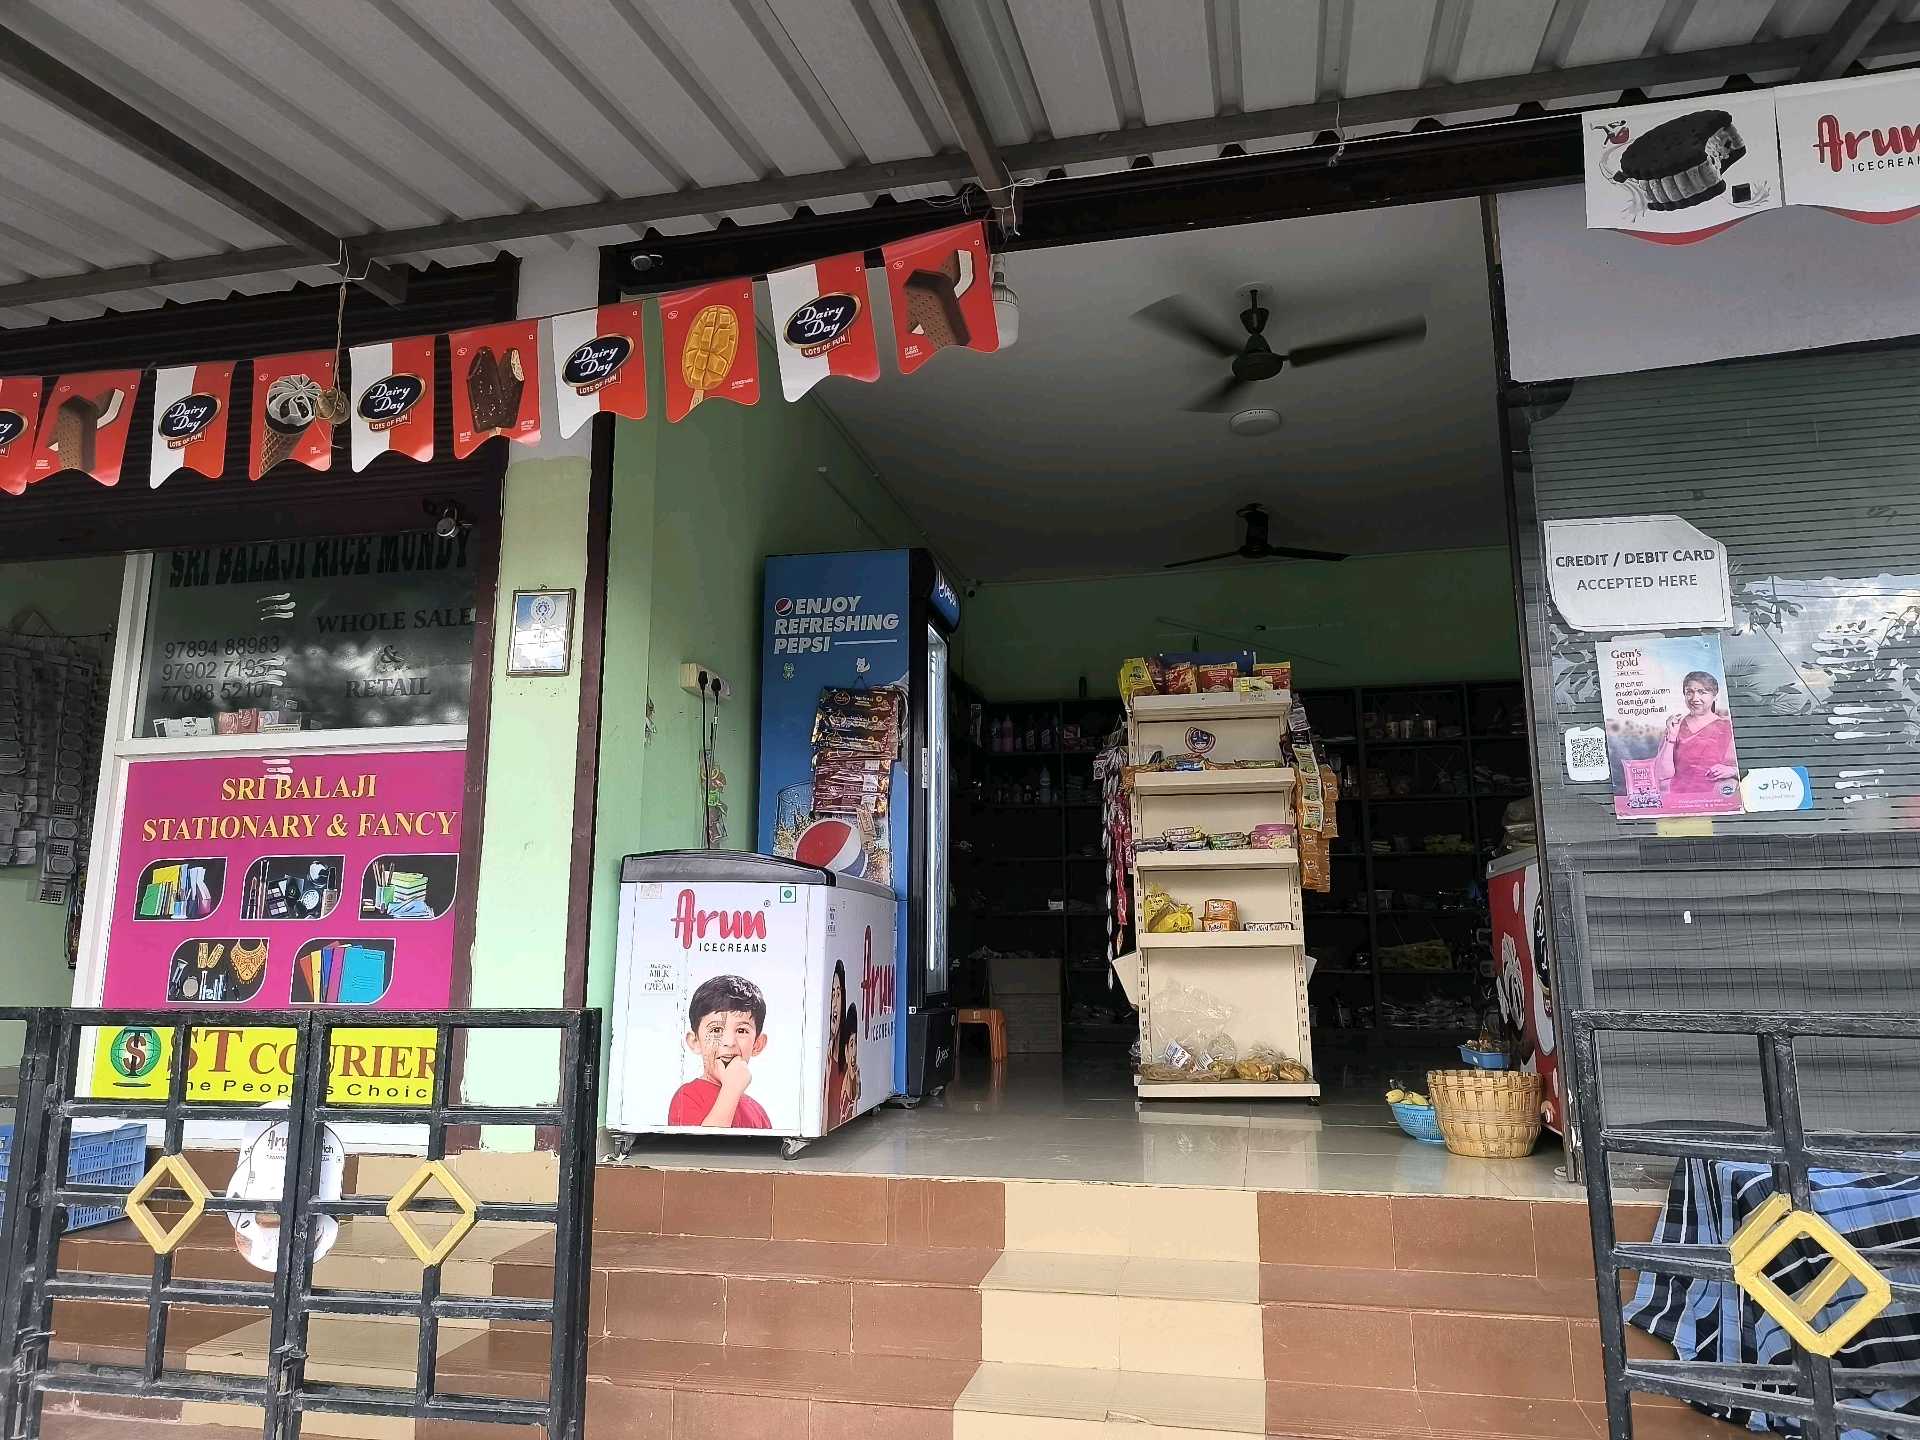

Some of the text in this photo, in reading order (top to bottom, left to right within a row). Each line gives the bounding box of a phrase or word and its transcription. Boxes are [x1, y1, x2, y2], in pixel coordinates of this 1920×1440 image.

[797, 305, 845, 326] Dairy
[805, 320, 840, 338] Day
[804, 334, 846, 356] LOTS OF FUN
[574, 346, 619, 364] Dairy
[580, 359, 613, 376] Day
[369, 383, 411, 399] Dairy
[579, 375, 617, 395] LOTS OF FUN
[170, 402, 207, 418] Dairy
[374, 396, 405, 414] Day
[172, 415, 202, 432] Day
[371, 413, 408, 430] LOTS OF FUN
[169, 433, 202, 448] LOTS OF FUN
[169, 548, 210, 588] SRI
[216, 542, 305, 585] BALAJI
[1555, 548, 1715, 568] CREDIT / DEBIT CARD
[1577, 574, 1698, 591] ACCEPTED HERE
[795, 595, 862, 615] ENJOY
[317, 607, 473, 634] WHOLE SALE
[774, 613, 900, 635] REFRESHING
[164, 635, 280, 660] 97894 88983
[379, 644, 405, 664] &
[774, 636, 831, 655] PEPSI
[1610, 648, 1642, 660] Gem's
[162, 661, 217, 682] 97902
[1616, 658, 1639, 670] gold
[345, 677, 432, 698] RETAIL
[221, 774, 377, 801] SRI BALAJI
[1771, 779, 1793, 792] Pay
[142, 811, 458, 842] STATIONARY & FANCY
[670, 888, 767, 950] Arun
[699, 942, 768, 953] ICECREAMS
[860, 925, 895, 1041] Arun
[347, 1082, 428, 1098] Choic
